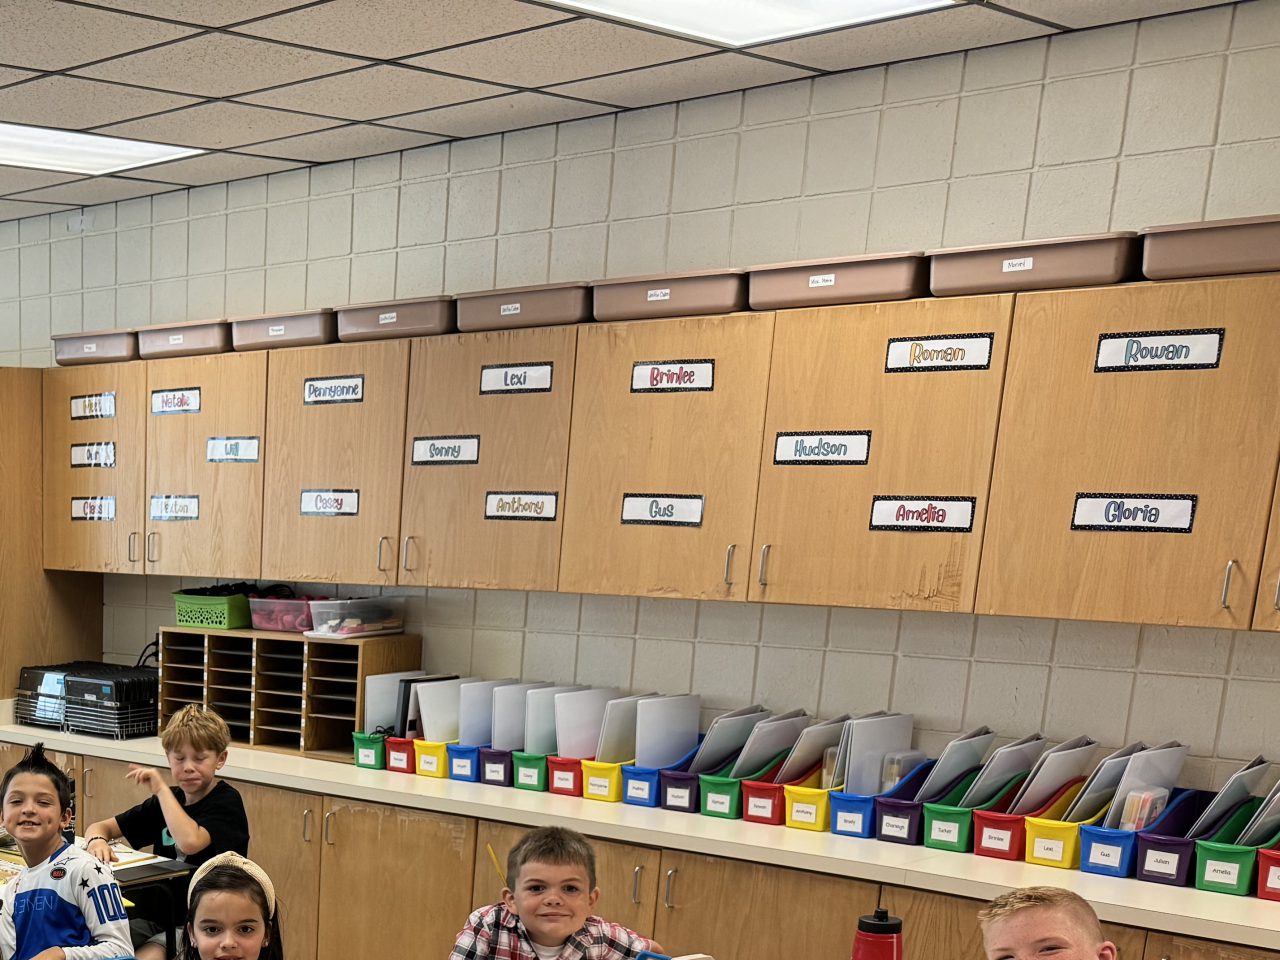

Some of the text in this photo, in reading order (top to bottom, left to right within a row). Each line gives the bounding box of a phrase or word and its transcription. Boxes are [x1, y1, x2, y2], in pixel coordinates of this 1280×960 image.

[909, 342, 965, 366] Roman
[1124, 339, 1190, 365] Rowan
[503, 371, 527, 387] Lexi
[649, 366, 695, 387] Brinlee
[308, 383, 359, 399] Pennyanne
[429, 443, 461, 458] Sonny
[794, 436, 848, 458] Hudson
[495, 497, 545, 515] Anthony
[649, 499, 675, 518] Gus
[895, 503, 947, 524] Amelia
[1104, 500, 1160, 524] Gloria
[85, 883, 128, 925] 100
